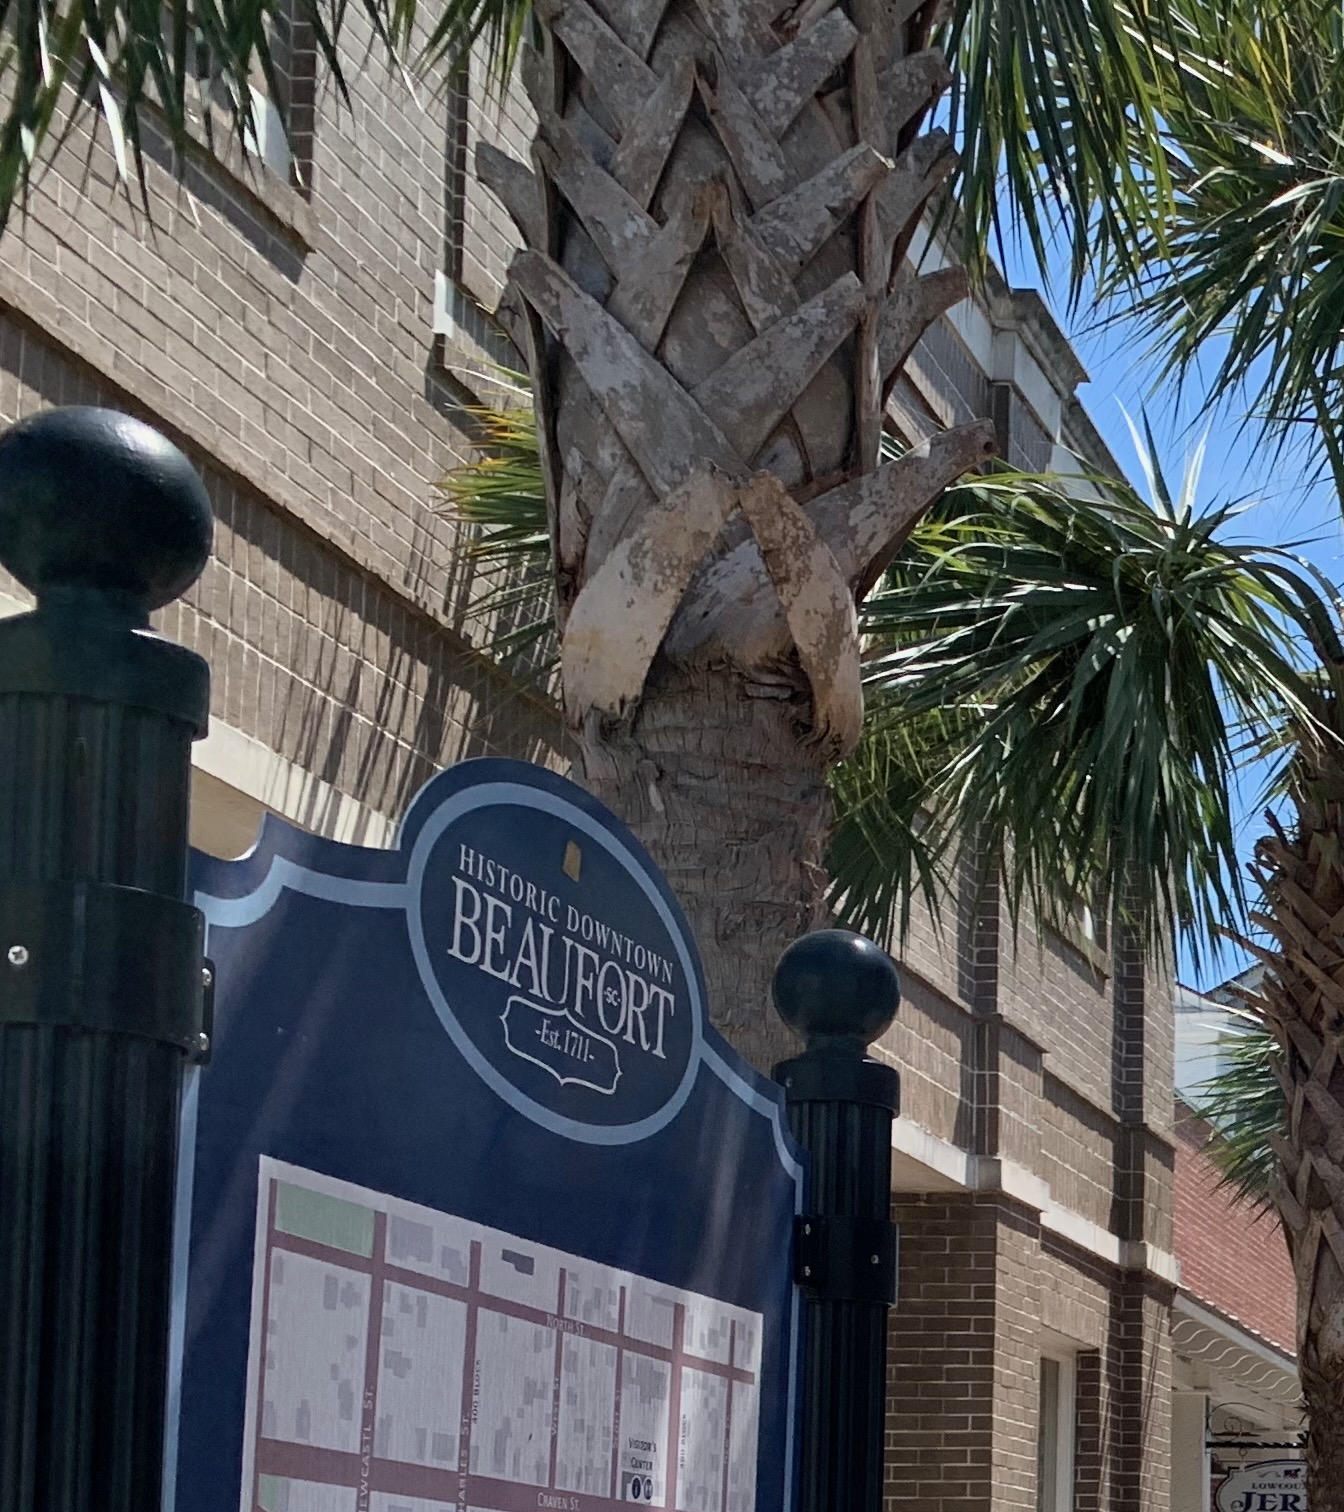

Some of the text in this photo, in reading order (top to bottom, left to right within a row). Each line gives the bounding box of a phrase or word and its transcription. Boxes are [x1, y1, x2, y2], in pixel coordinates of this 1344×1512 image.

[459, 844, 673, 984] HISTORIC DOWNTOWN
[447, 875, 675, 1059] BEAUFORT
[537, 1492, 568, 1510] CRAVEN
[1231, 1491, 1307, 1512] JER
